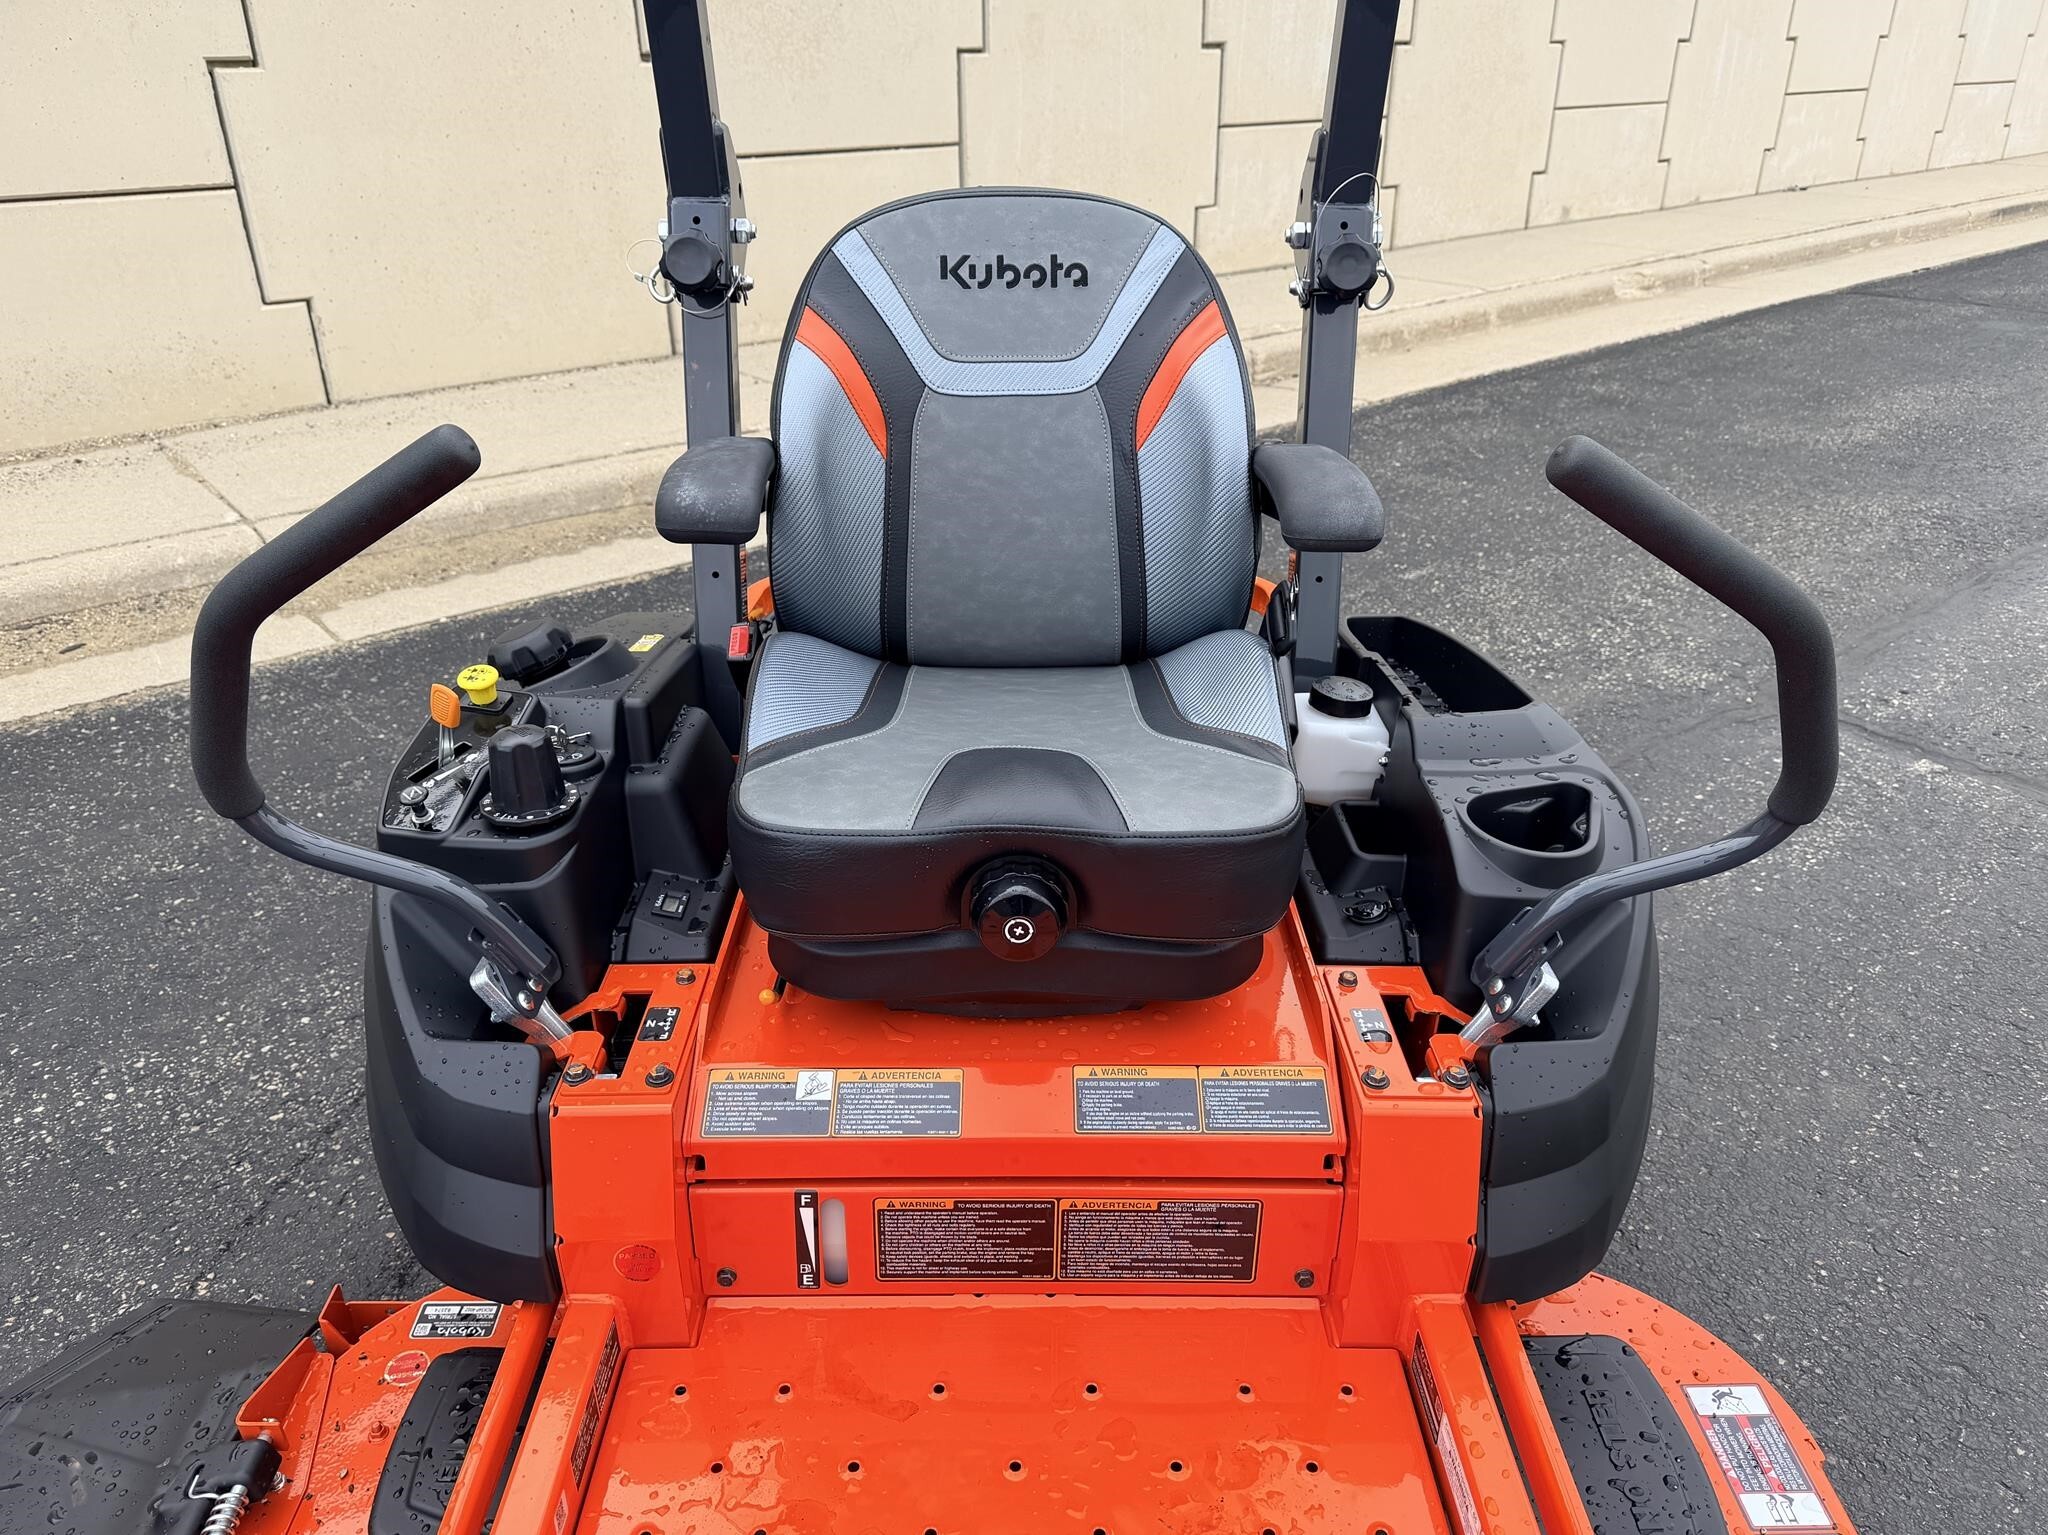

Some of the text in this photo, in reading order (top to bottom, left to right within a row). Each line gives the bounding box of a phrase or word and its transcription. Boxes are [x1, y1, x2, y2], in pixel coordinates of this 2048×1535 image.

[940, 254, 1089, 290] Kubota
[738, 1071, 786, 1080] WARNING
[871, 1071, 942, 1080] ADVERTENCIA
[1101, 1068, 1148, 1077] WARNING
[1232, 1069, 1304, 1077] ADVERTENCIA
[801, 1194, 812, 1206] F
[802, 1274, 814, 1285] E
[437, 1326, 486, 1337] Kubota
[1705, 1429, 1733, 1471] DANGER
[1744, 1427, 1773, 1468] PELIGRO
[1712, 1423, 1752, 1491] DO NOT PUT HANDS OR
[1719, 1417, 1761, 1491] FEET INTO MOWER WHEN
[1754, 1466, 1771, 1491] ENGINE
